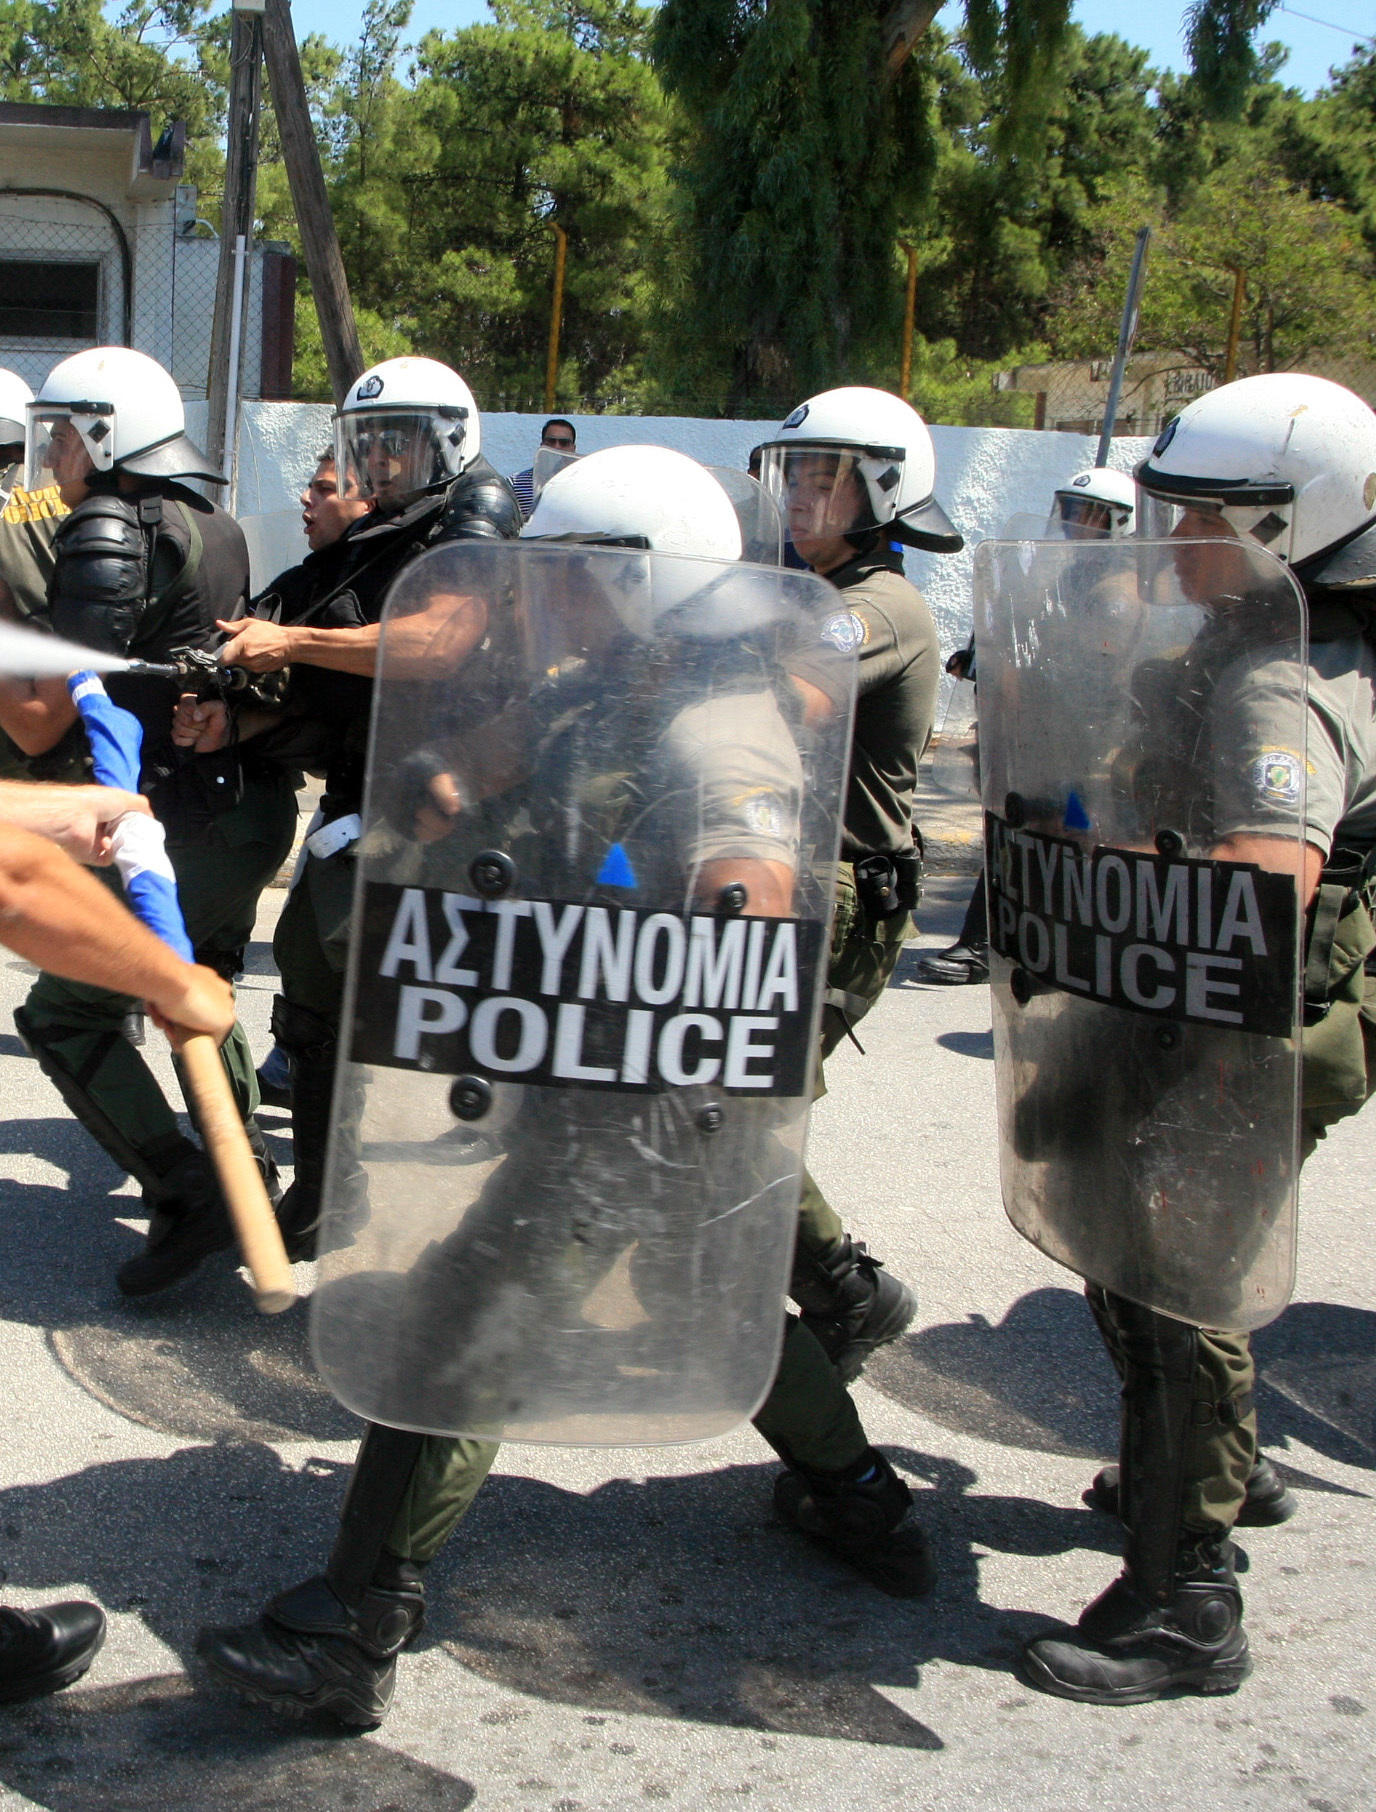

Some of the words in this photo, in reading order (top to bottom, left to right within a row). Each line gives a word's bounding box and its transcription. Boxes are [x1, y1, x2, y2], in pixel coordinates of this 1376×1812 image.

[379, 887, 798, 1012] ΑΣΤΥΝΟΜΙΑ
[998, 894, 1244, 1024] POLICE
[393, 984, 780, 1088] POLICE
